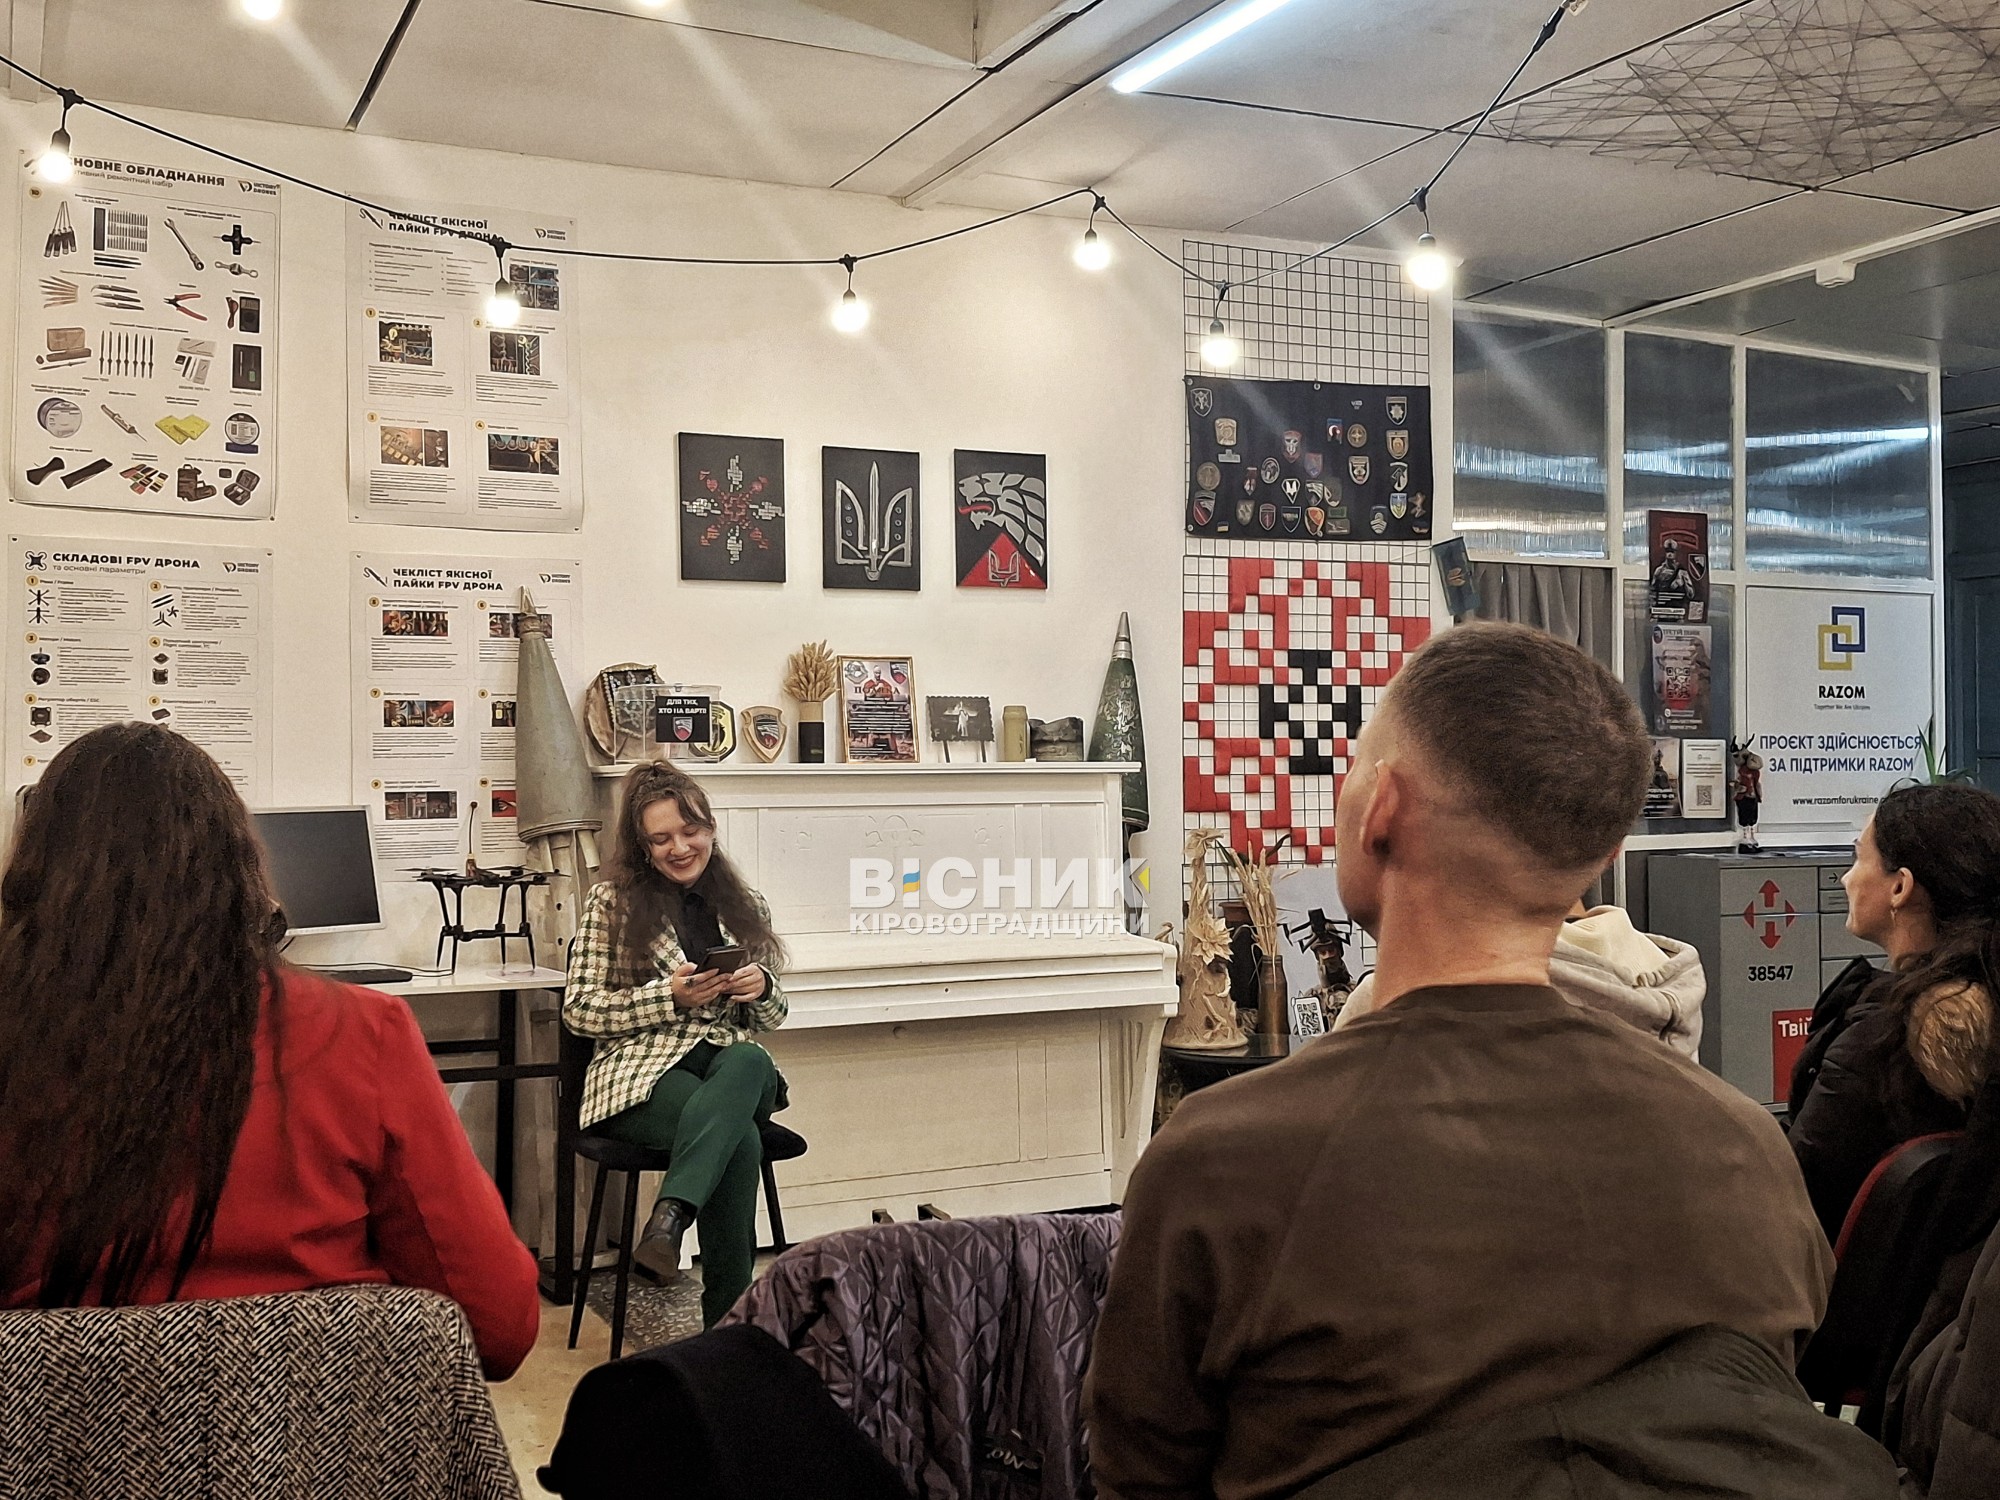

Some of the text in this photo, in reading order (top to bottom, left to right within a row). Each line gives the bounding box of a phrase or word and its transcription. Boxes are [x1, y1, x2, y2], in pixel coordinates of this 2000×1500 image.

[74, 157, 225, 186] НОВНЕ ОБЛАДНАННЯ
[389, 222, 430, 234] ПАЙКИ
[441, 218, 488, 229] ЯКІСНОЇ
[53, 553, 200, 568] СКЛАДОВІ FPV ДРОНА
[99, 567, 146, 575] параметри
[393, 568, 493, 580] ЧЕКЛІСТ ЯКІСНОЇ
[393, 578, 504, 591] ПАЙКИ FPV ДРОНА
[1819, 685, 1866, 699] RAZOM
[1760, 732, 1921, 752] ПРОЄКТ ЗДІЙСНЮЄТЬСЯ
[1769, 757, 1913, 774] ЗА ПІДТРИМКИ RAZOM
[1792, 795, 1889, 805] www.razomforukraine
[1748, 965, 1794, 981] 38547
